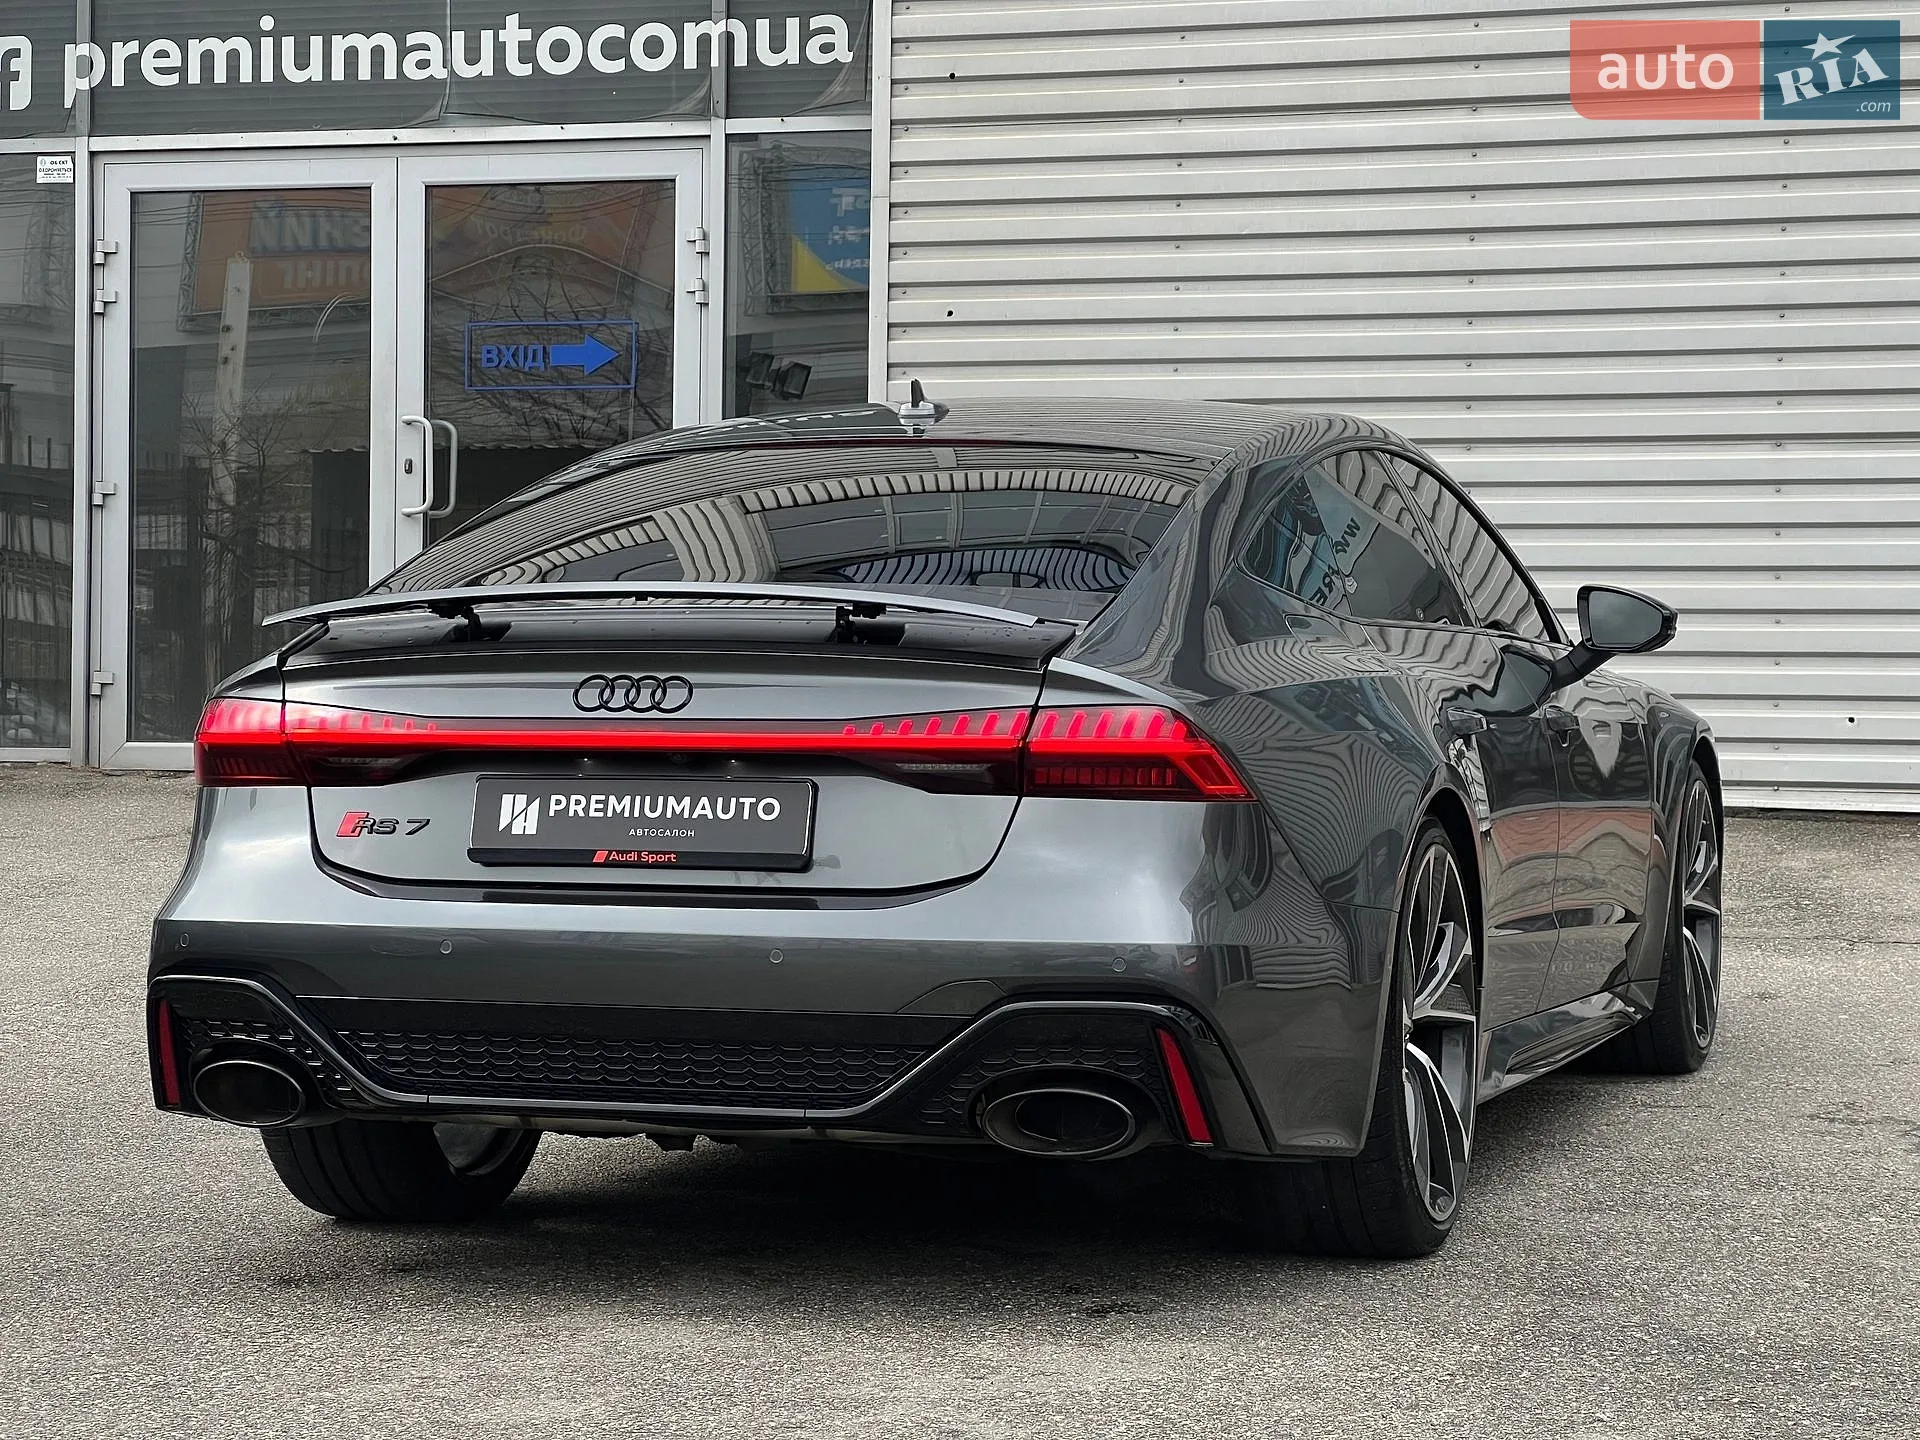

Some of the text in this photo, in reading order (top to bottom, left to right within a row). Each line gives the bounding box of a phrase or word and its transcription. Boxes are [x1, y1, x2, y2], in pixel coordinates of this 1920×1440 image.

[64, 12, 854, 109] premiumautocomua
[480, 344, 546, 371] ВХІД
[548, 794, 781, 821] PREMIUMAUTO
[340, 812, 431, 836] RS 7
[628, 828, 695, 837] АВТОСАЛОН
[608, 850, 677, 864] Audi Sport
